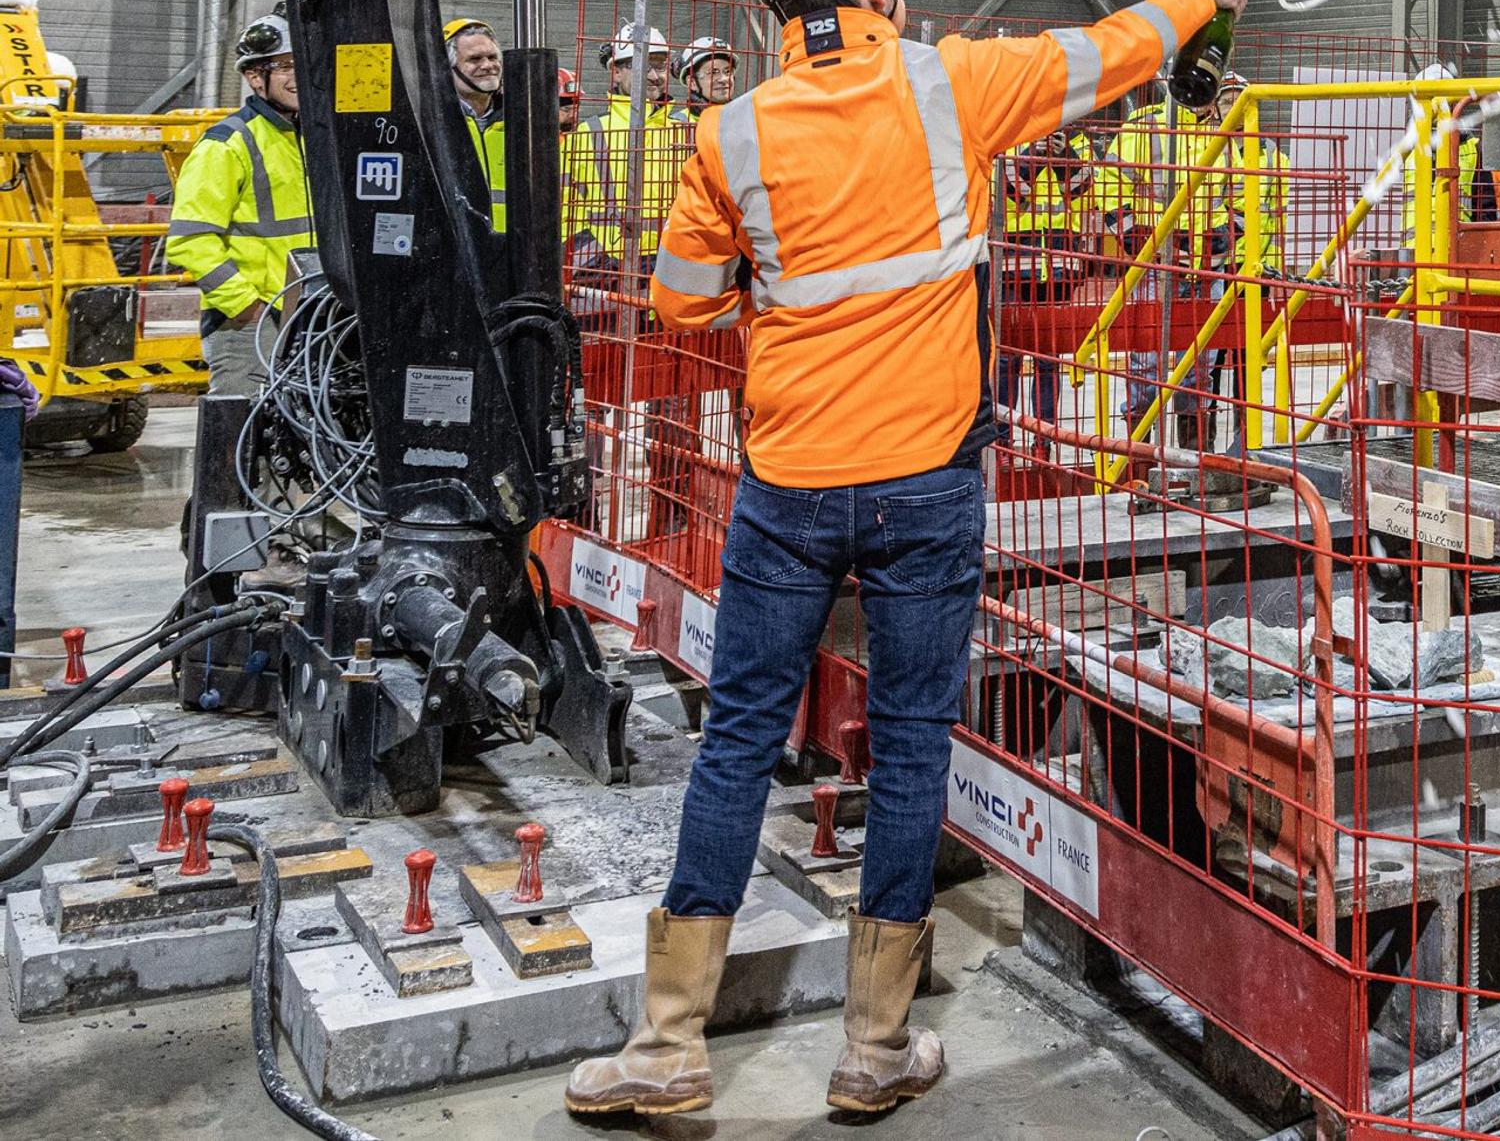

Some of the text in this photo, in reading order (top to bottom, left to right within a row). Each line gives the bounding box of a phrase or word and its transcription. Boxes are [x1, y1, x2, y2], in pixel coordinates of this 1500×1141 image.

[806, 18, 836, 36] T2S
[1416, 530, 1464, 549] OLLECTION
[575, 562, 605, 587] VINCI
[685, 620, 714, 651] VINC
[954, 772, 1013, 826] VINCI
[975, 811, 1020, 848] CONSTRUCTION
[1057, 838, 1091, 874] FRANCE
